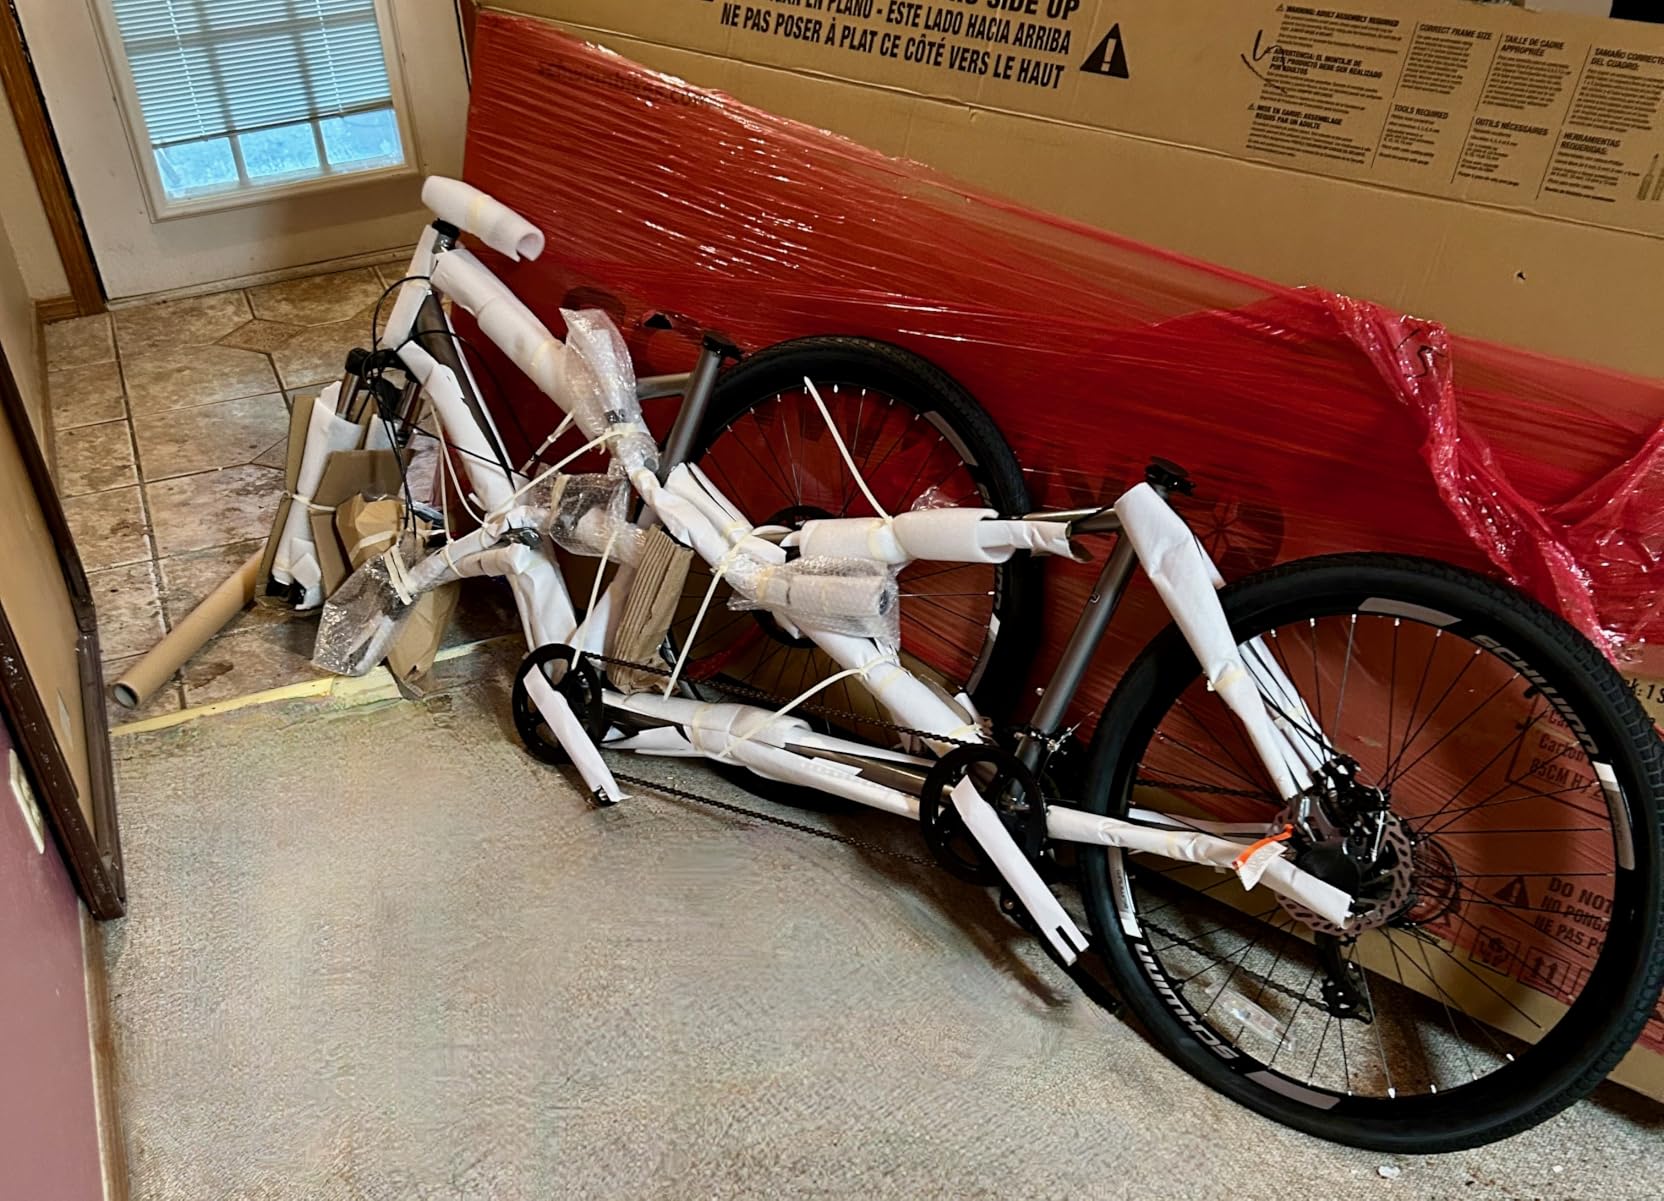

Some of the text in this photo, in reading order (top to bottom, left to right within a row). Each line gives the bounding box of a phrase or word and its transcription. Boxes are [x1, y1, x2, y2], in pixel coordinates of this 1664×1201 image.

[1046, 0, 1080, 20] UP
[886, 0, 923, 28] ESTE
[924, 6, 964, 35] LADO
[965, 13, 1011, 44] HACIA
[1012, 22, 1072, 55] ARRIBA
[1476, 31, 1493, 40] SIZE
[720, 2, 1065, 89] NE PAS POSER À PLAT CE CÔTÉ VERS LE HAUT
[1394, 104, 1414, 115] TOOLS
[1475, 117, 1500, 129] OUTILS
[1471, 634, 1600, 755] SCHWINN
[1550, 876, 1613, 914] DO NOT
[1557, 924, 1584, 948] PAS
[1135, 943, 1240, 1060] SCHWINN
